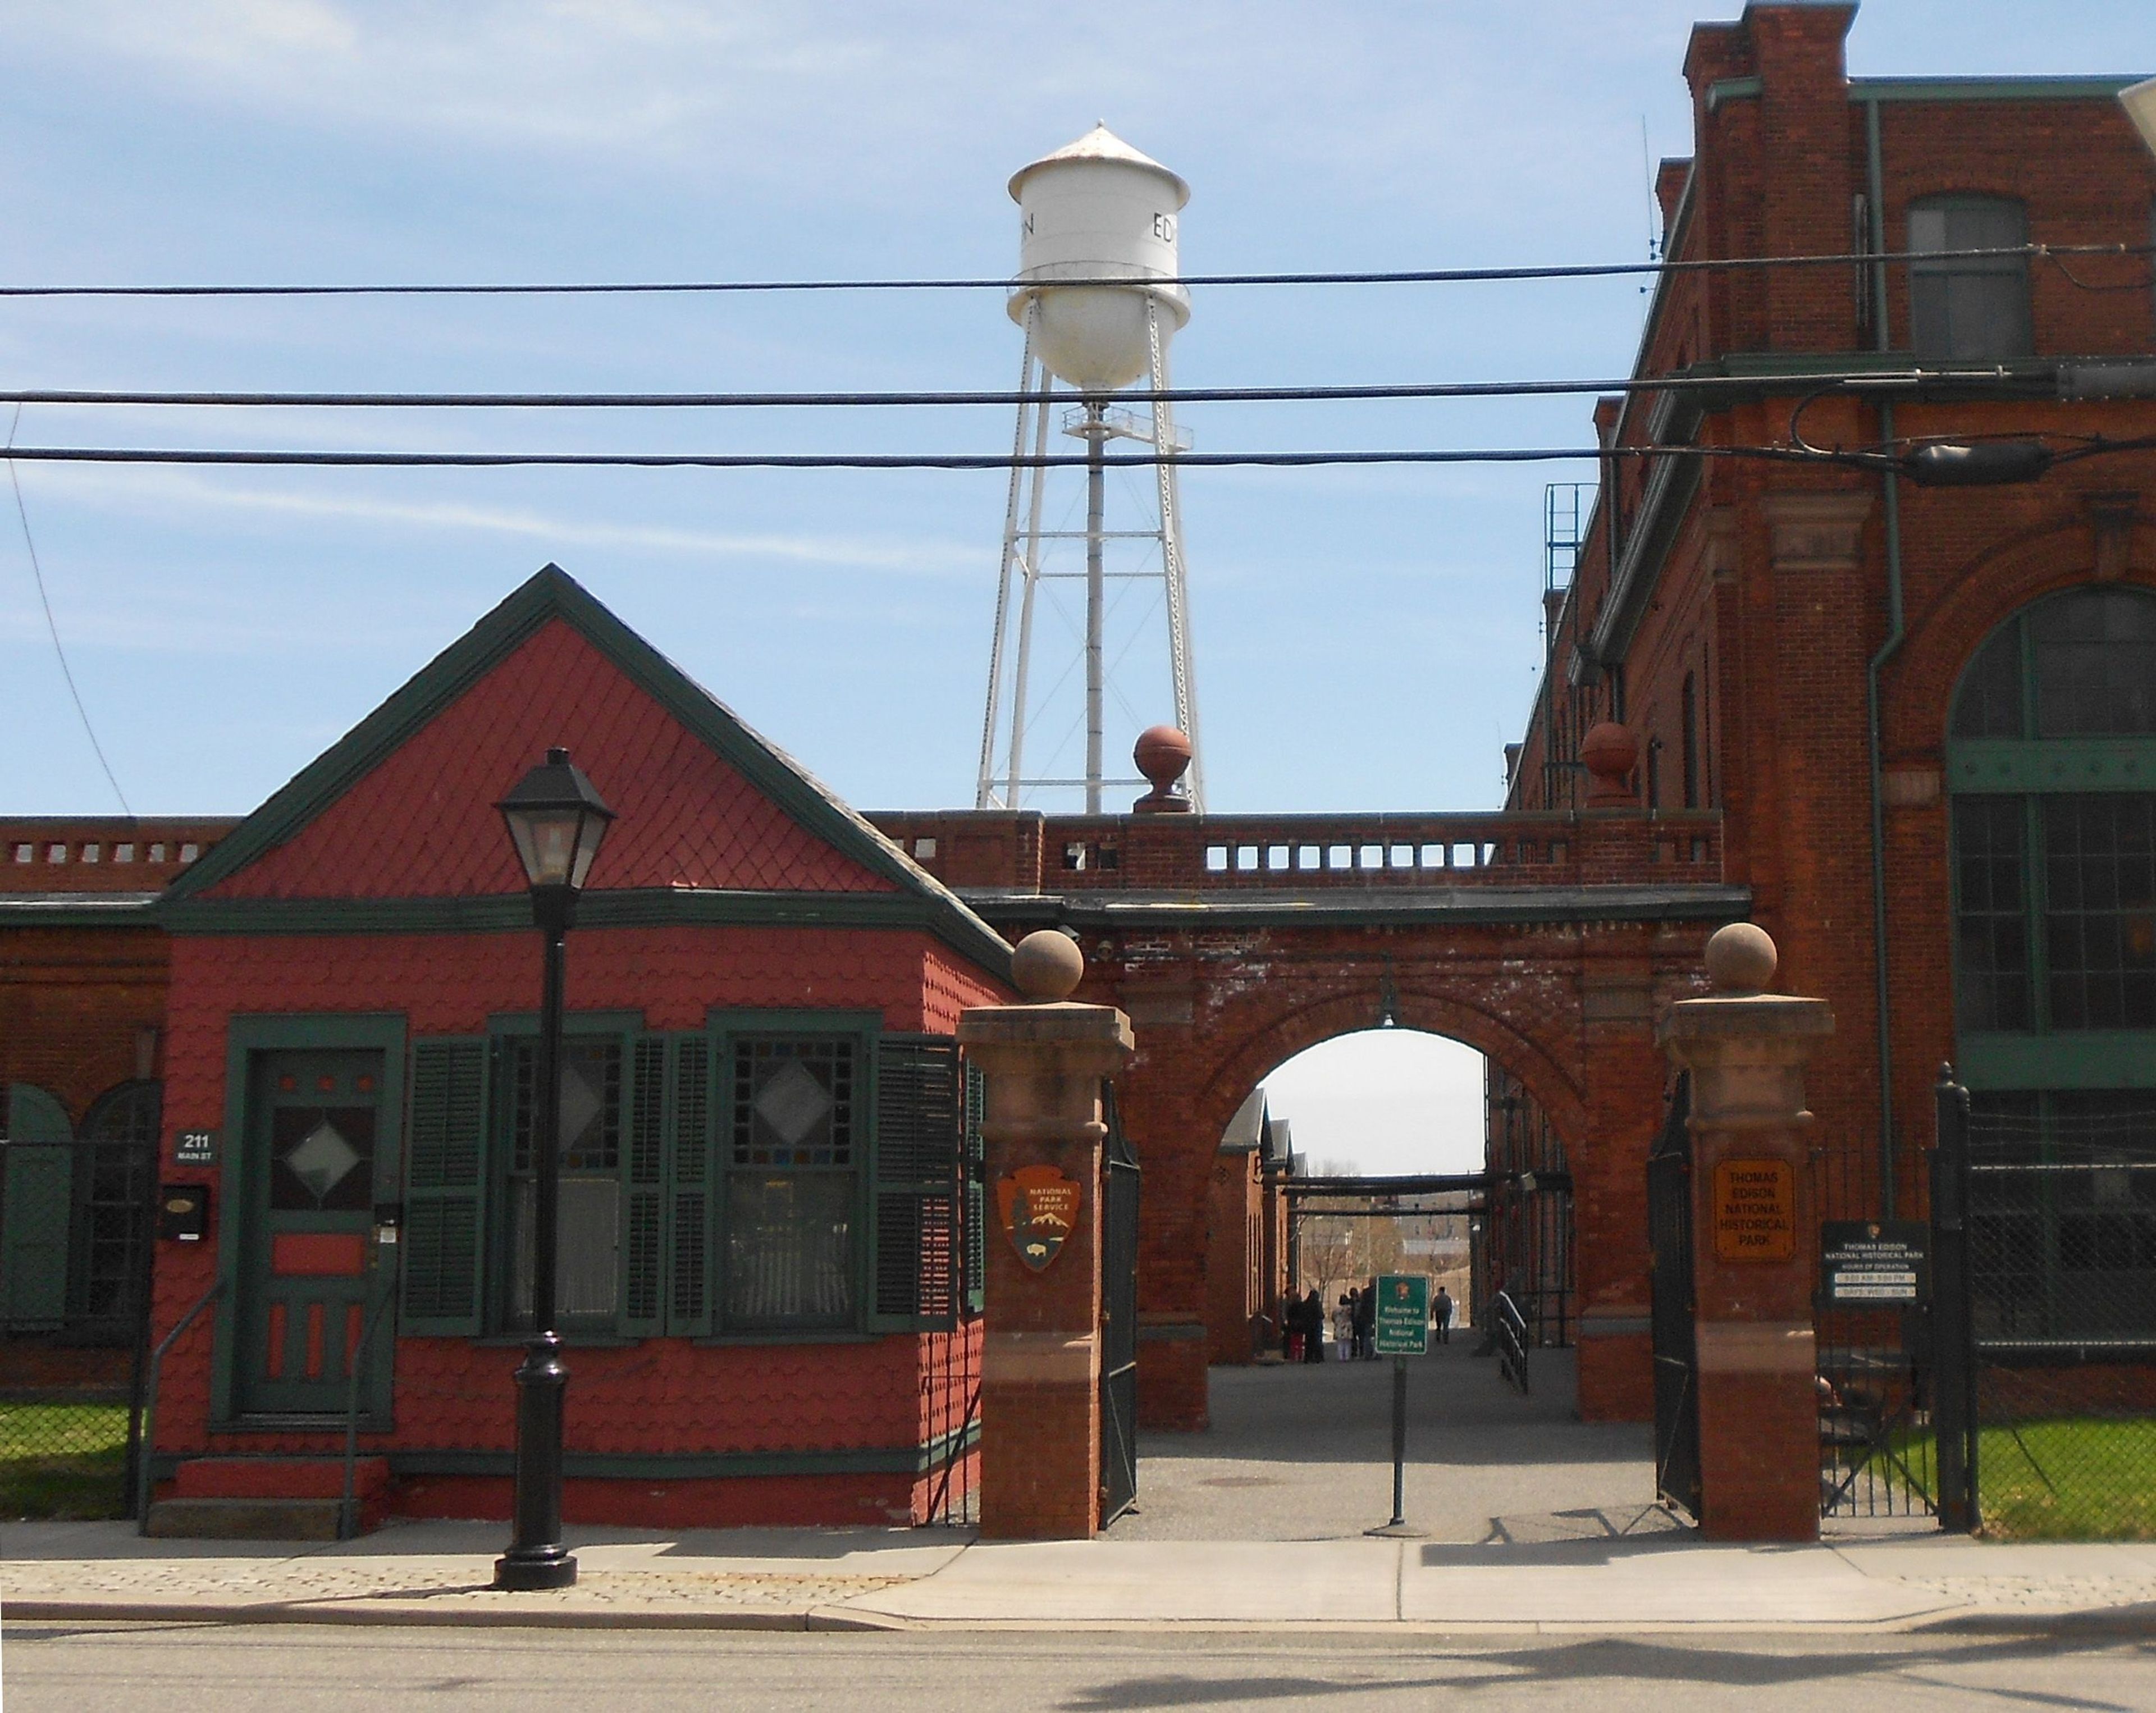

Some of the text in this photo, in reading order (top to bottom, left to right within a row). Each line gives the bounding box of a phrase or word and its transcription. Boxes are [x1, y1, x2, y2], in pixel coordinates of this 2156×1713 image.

[184, 1134, 208, 1148] 211
[1730, 1172, 1778, 1182] THOMAS
[1733, 1187, 1775, 1199] EDISON
[1725, 1204, 1784, 1214] NATIONAL
[1720, 1218, 1789, 1230] HISTORICAL
[1739, 1235, 1769, 1246] PARK
